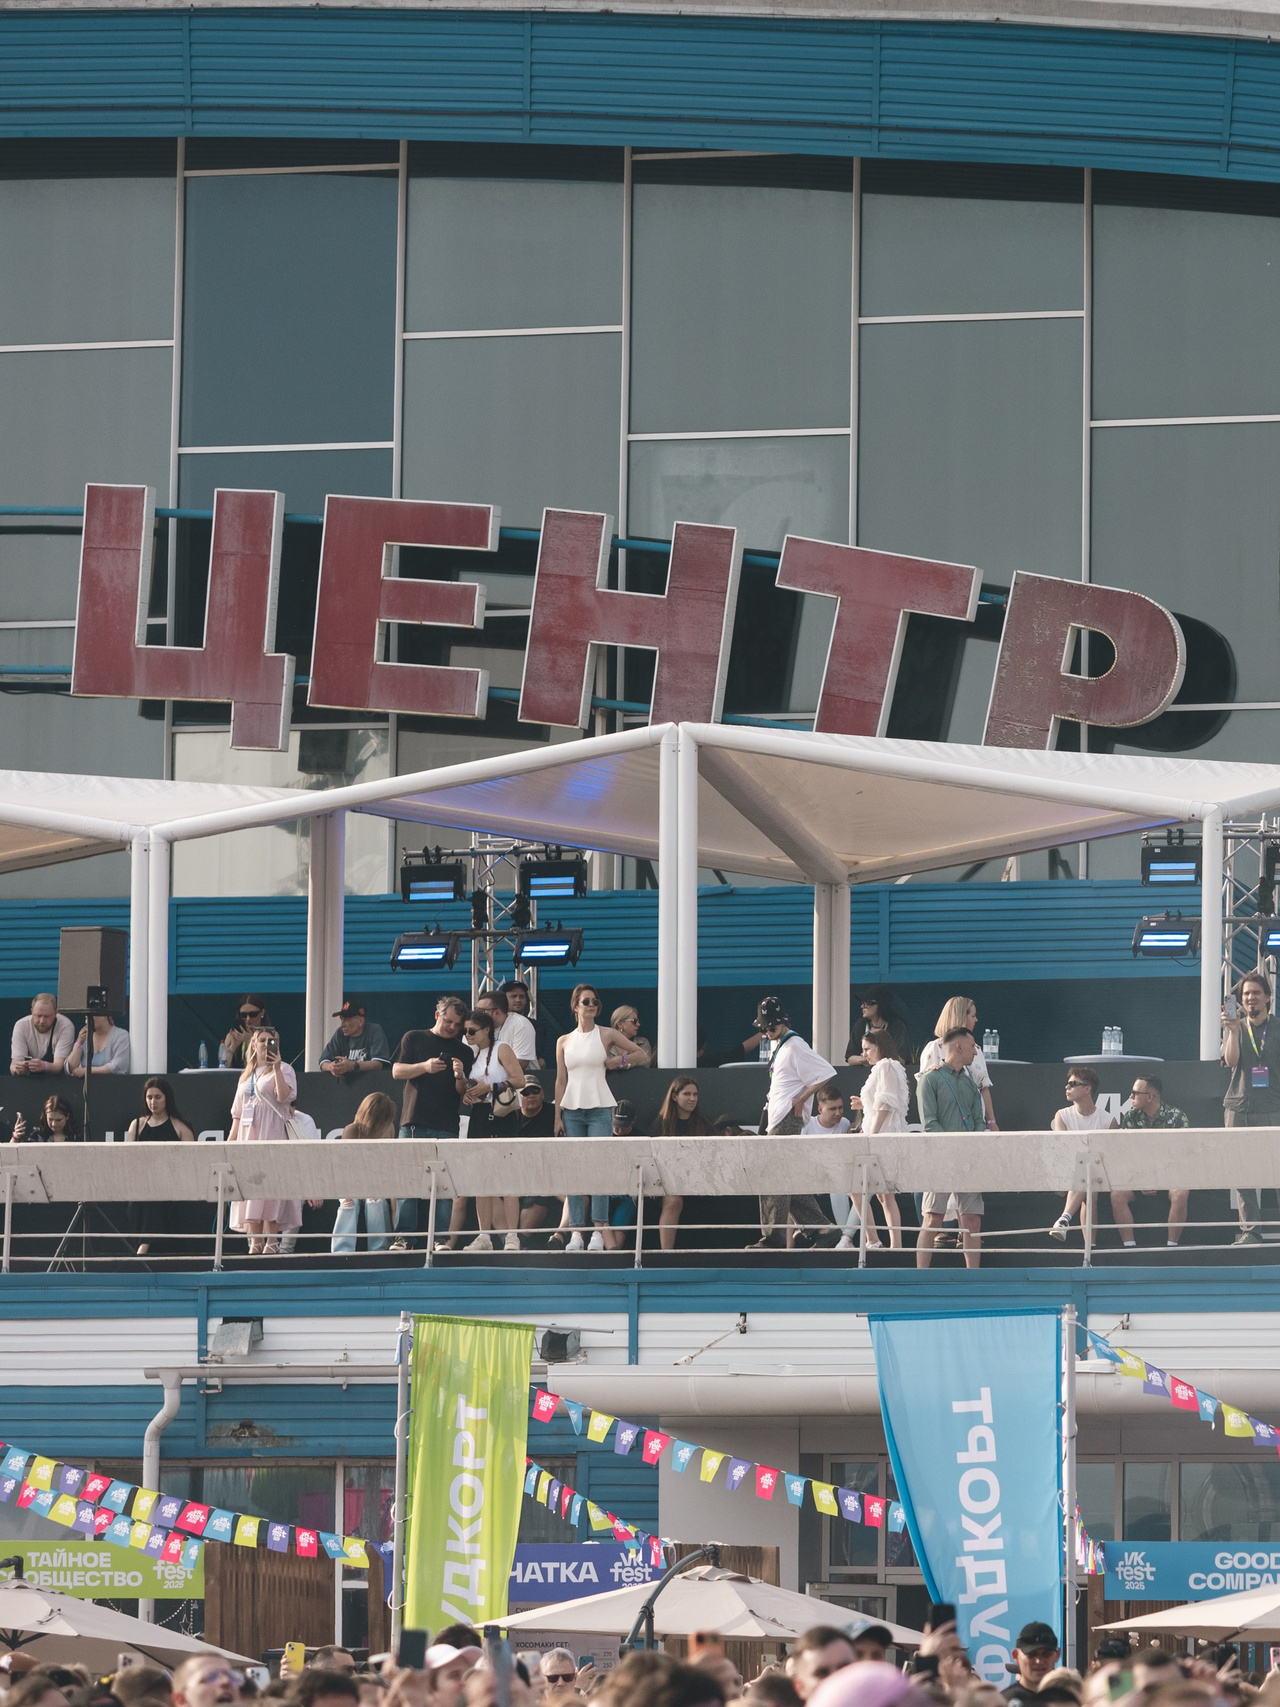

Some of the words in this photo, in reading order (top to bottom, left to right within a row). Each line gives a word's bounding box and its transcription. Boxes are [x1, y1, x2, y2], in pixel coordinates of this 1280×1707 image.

[72, 484, 1187, 750] ЦЕНТР
[27, 1548, 111, 1568] ТАЙНОЕ
[1124, 1552, 1146, 1566] VK
[0, 1570, 143, 1589] ОБЩЕСТВО
[153, 1559, 193, 1580] fest
[609, 1561, 653, 1583] fest
[1116, 1560, 1156, 1581] fest
[163, 1580, 185, 1589] 2025
[1125, 1581, 1145, 1590] 2025
